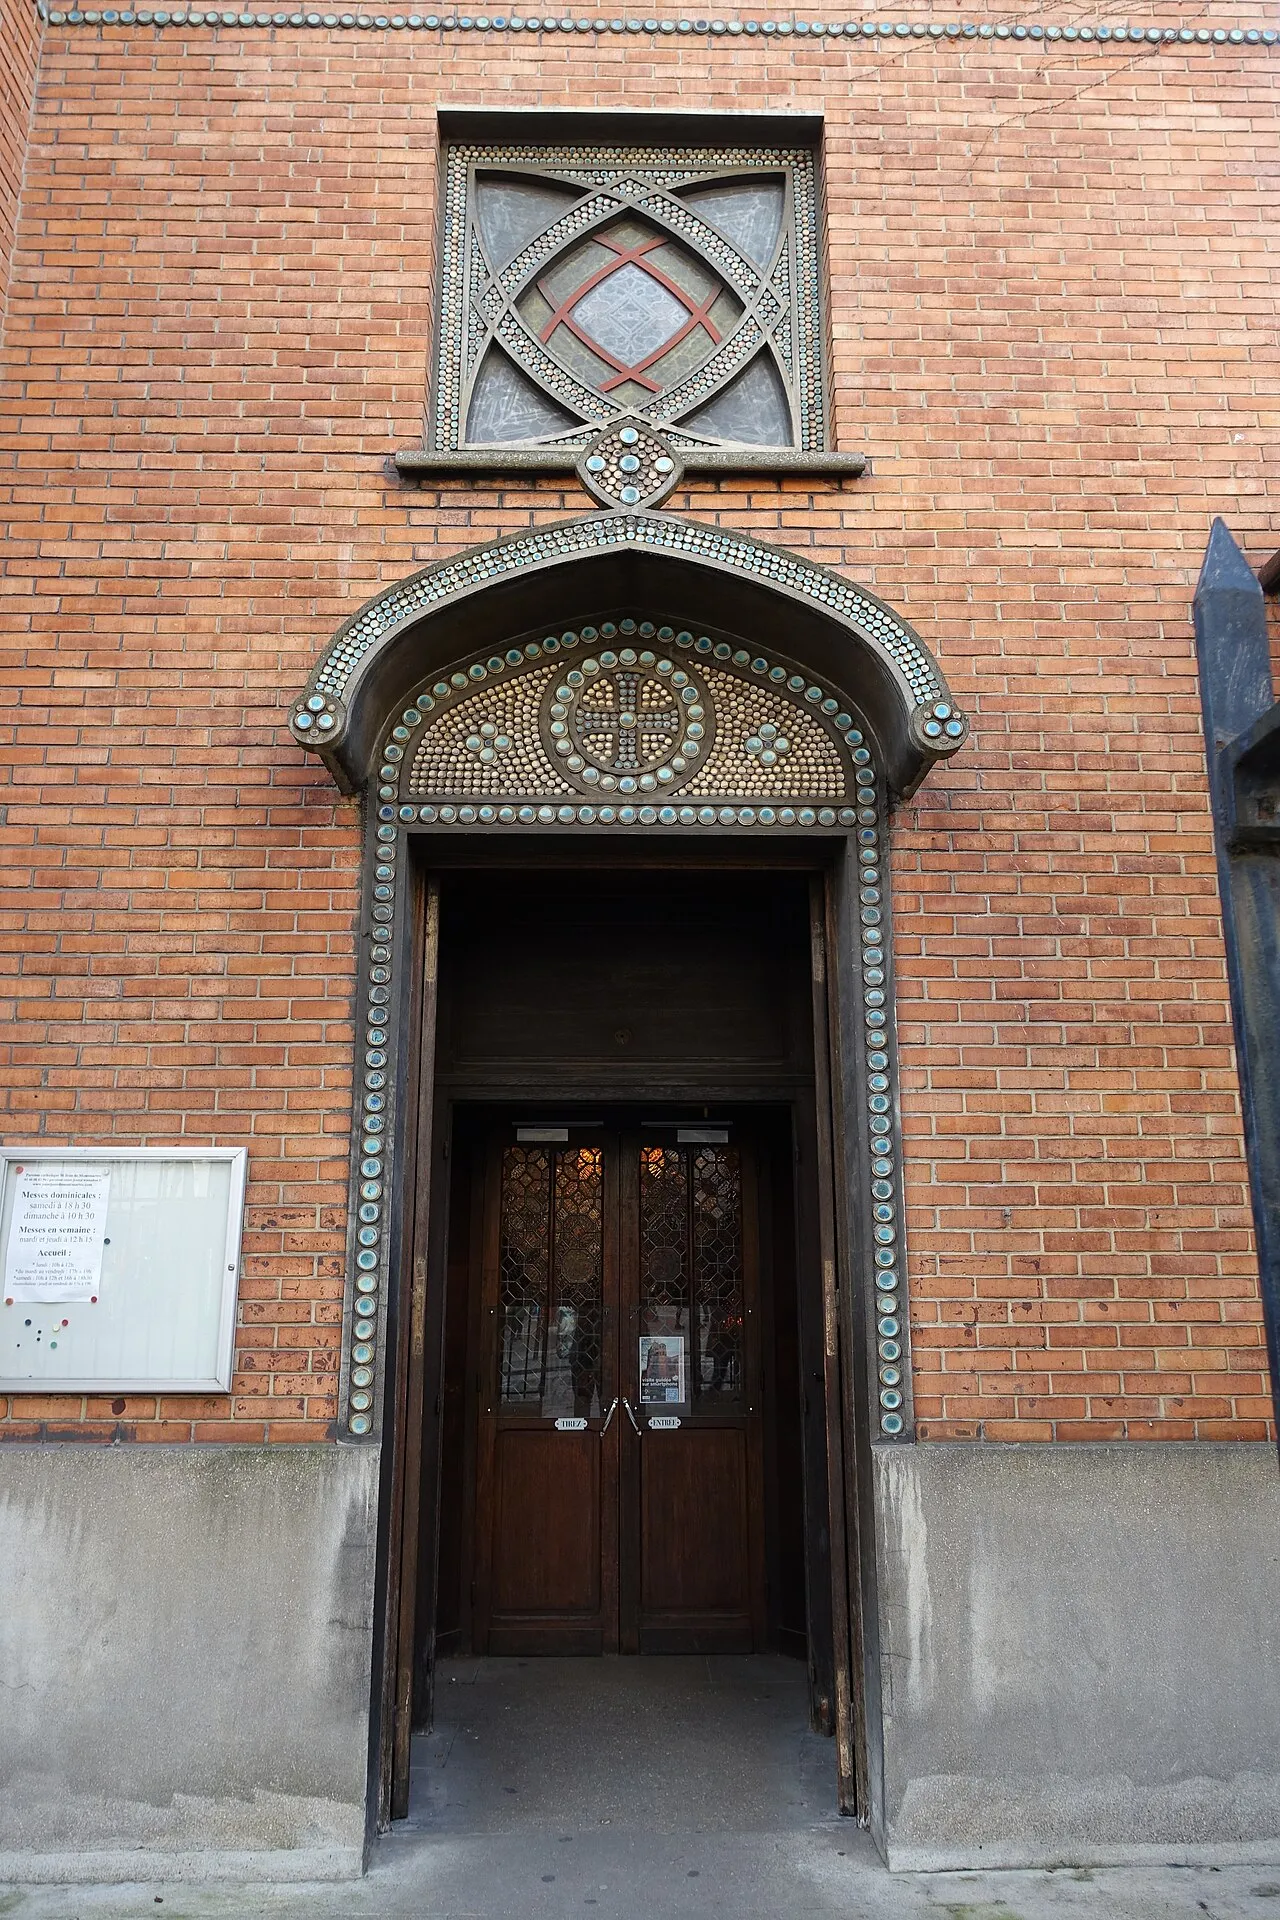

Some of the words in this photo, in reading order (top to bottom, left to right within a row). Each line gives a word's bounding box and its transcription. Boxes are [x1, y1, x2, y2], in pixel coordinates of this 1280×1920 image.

[22, 1191, 48, 1199] Messes
[50, 1191, 96, 1199] dominicales
[30, 1201, 56, 1209] samedi
[57, 1201, 62, 1209] à
[64, 1201, 73, 1209] 18
[74, 1201, 80, 1209] h
[81, 1201, 91, 1210] 30
[24, 1212, 60, 1220] dimanche
[60, 1212, 65, 1220] à
[67, 1212, 77, 1220] 10
[78, 1212, 83, 1220] h
[84, 1212, 95, 1220] 30
[19, 1226, 46, 1234] Messes
[59, 1226, 91, 1234] semaine
[45, 1236, 62, 1244] jeudi
[561, 1420, 582, 1428] TIREZ
[653, 1418, 678, 1426] ENTRÉE
